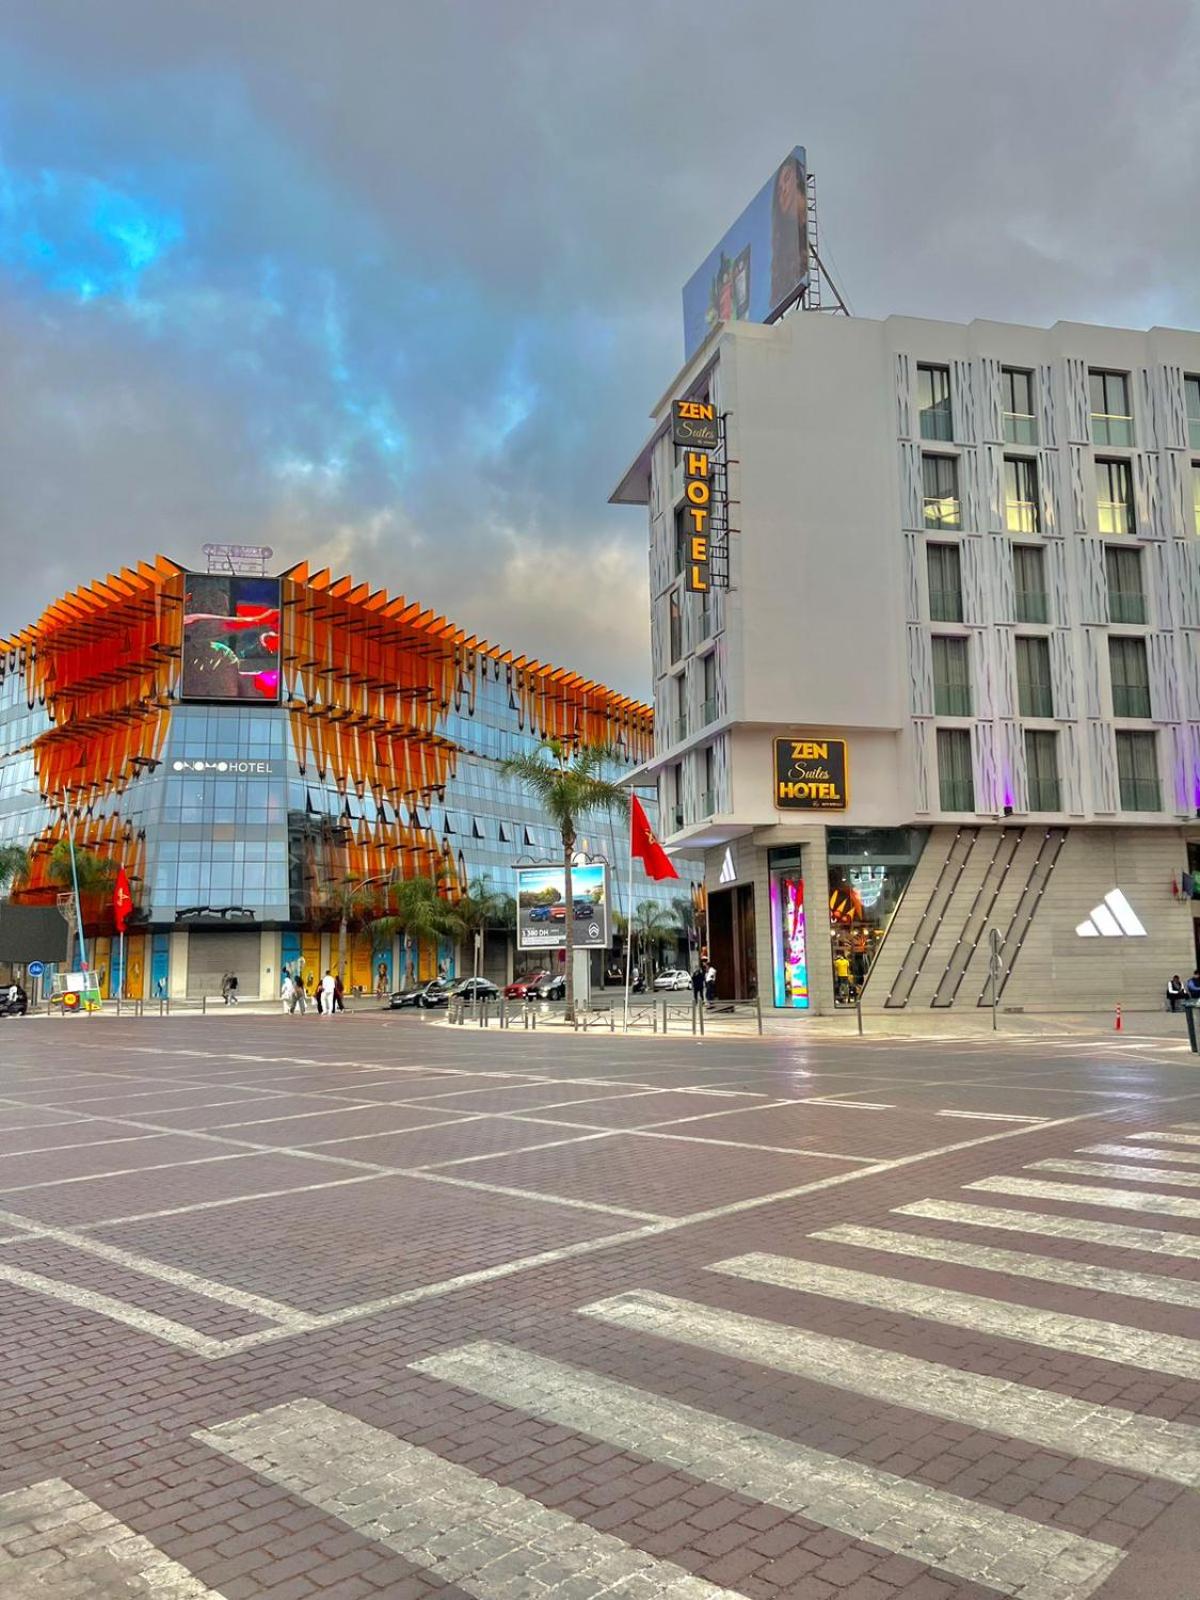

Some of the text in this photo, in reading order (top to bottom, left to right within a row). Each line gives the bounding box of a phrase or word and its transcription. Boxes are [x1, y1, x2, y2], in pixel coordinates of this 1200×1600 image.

[678, 401, 714, 420] ZEN
[677, 421, 714, 438] Suites
[687, 452, 710, 590] HOTEL
[791, 742, 828, 759] ZEN
[229, 762, 273, 773] HOTEL
[788, 761, 830, 780] Suites
[780, 782, 840, 799] HOTEL
